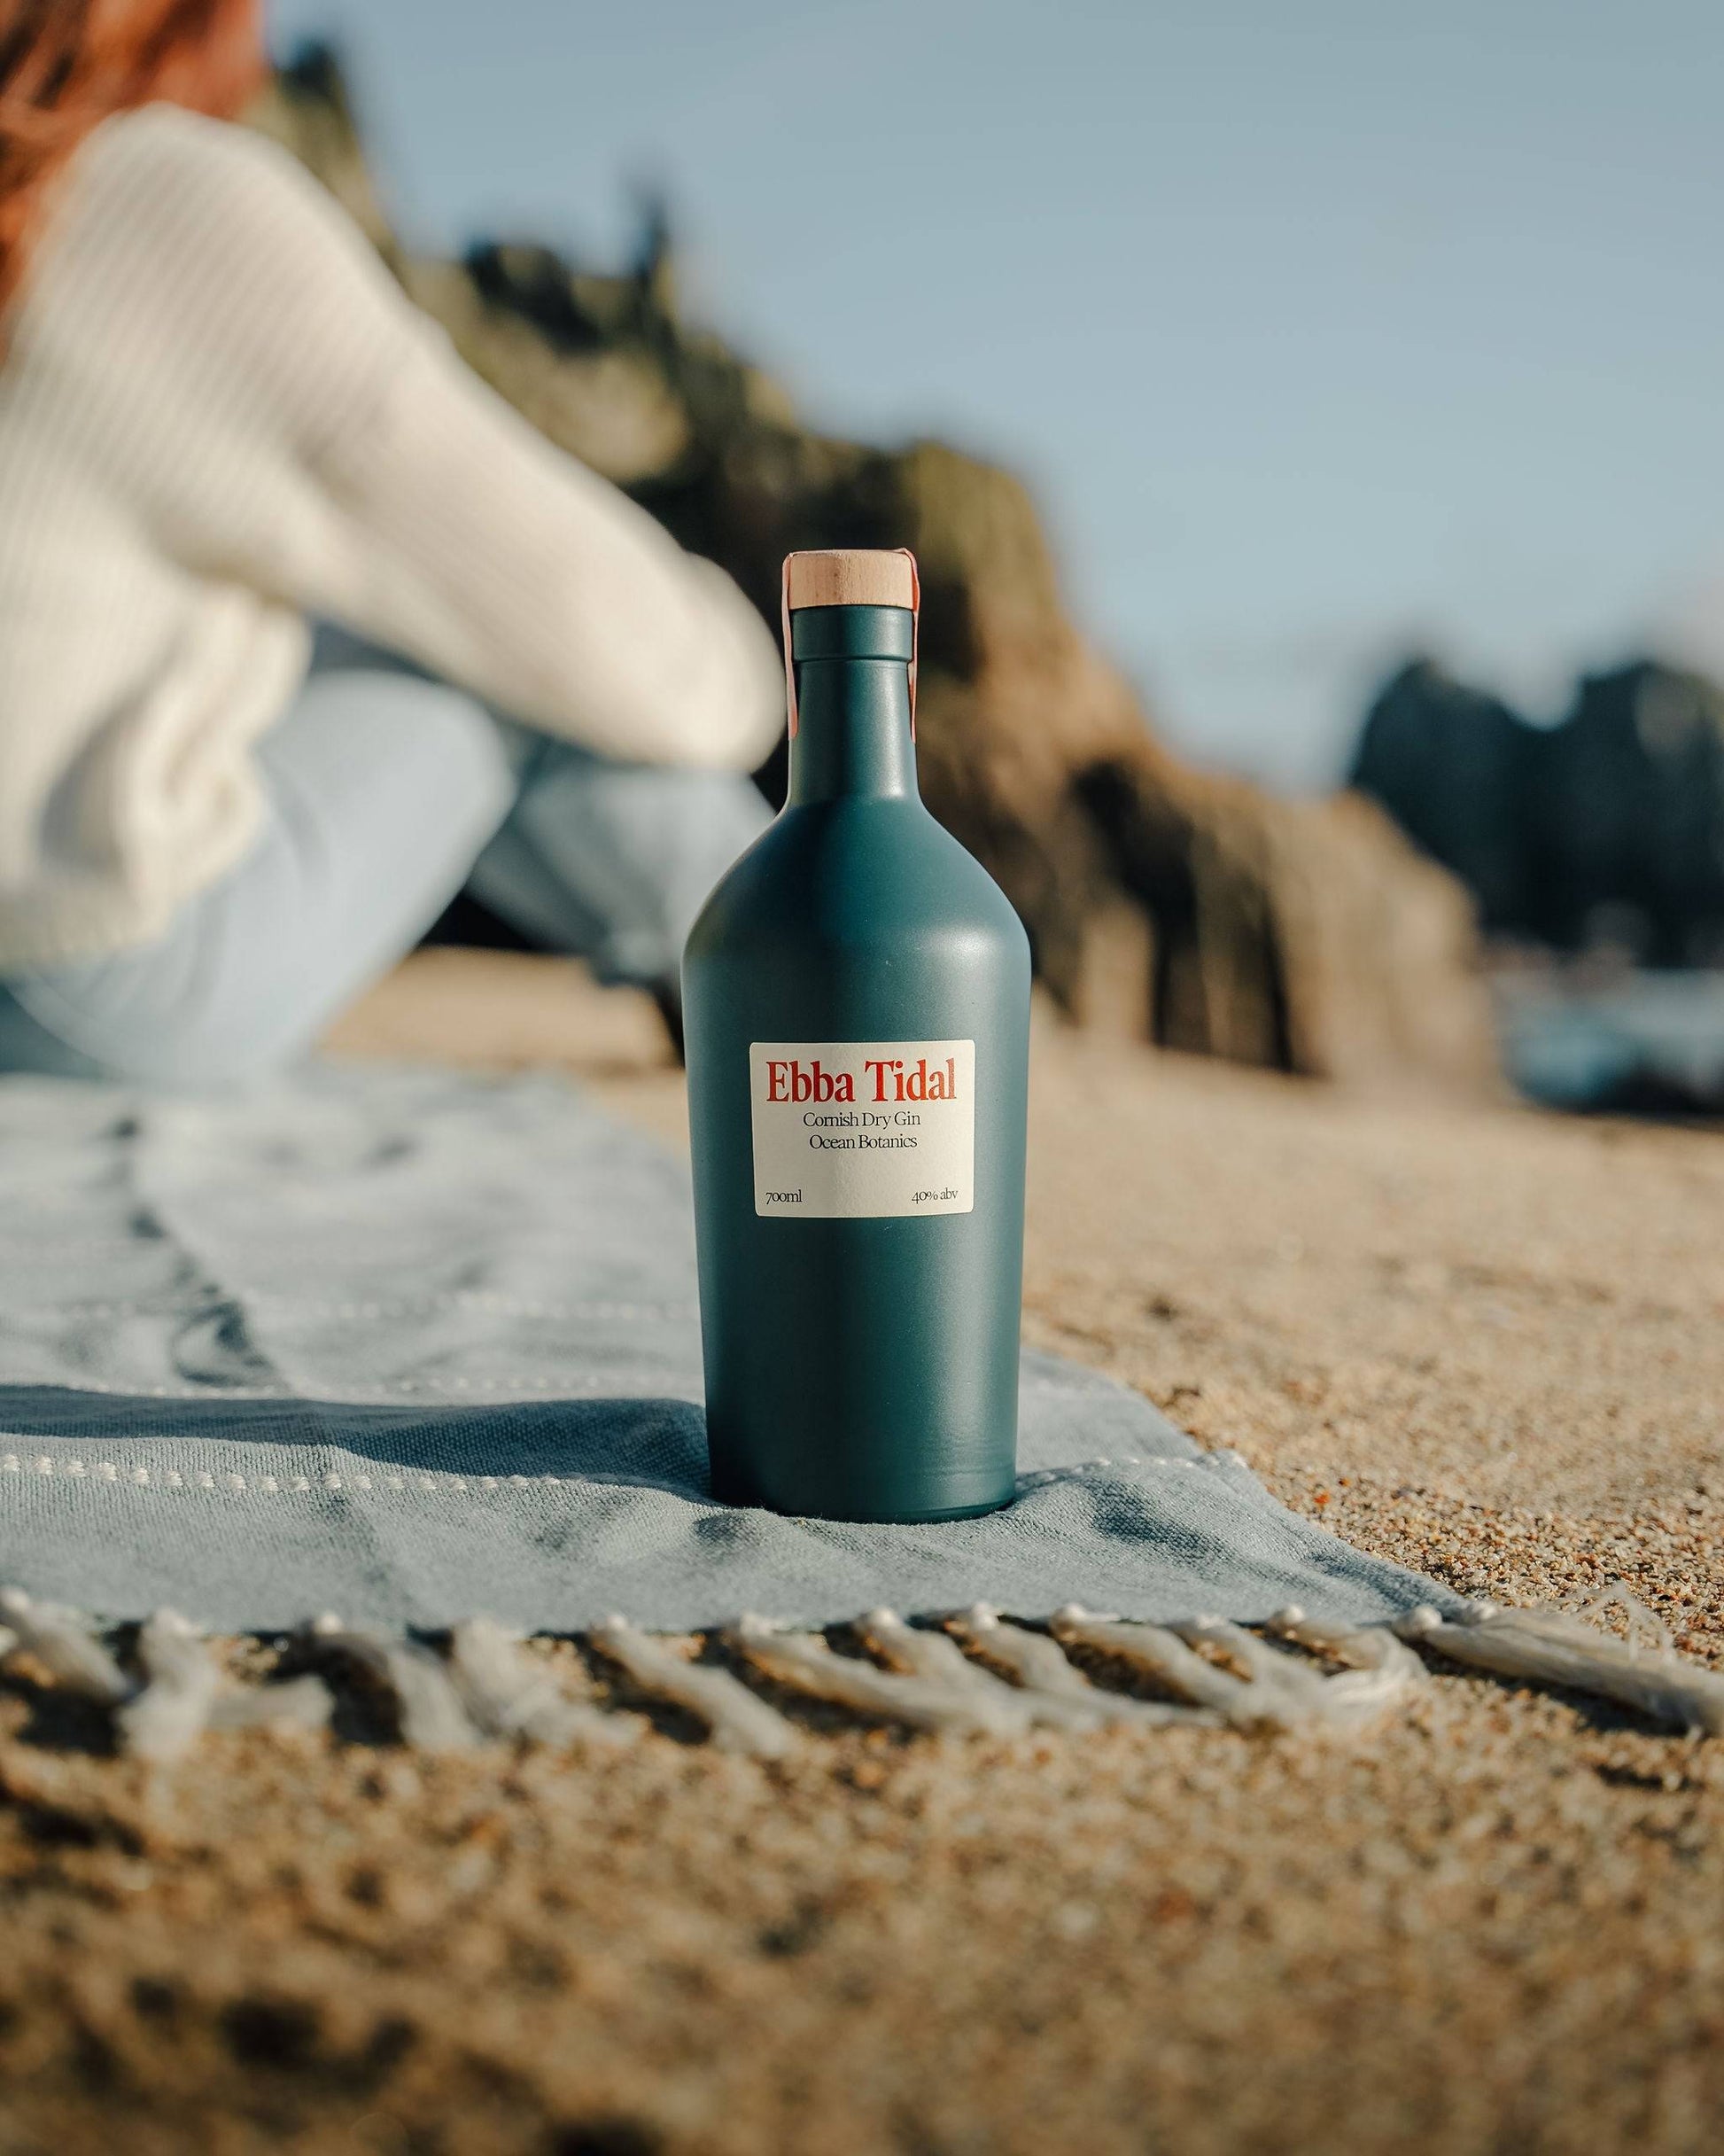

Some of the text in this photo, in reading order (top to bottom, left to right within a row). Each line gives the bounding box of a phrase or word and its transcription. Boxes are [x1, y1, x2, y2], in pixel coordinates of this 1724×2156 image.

[766, 1057, 958, 1102] Ebba Tidal
[803, 1110, 921, 1130] Cornish Dry Gin
[809, 1133, 918, 1149] Ocean Botanics
[765, 1189, 803, 1205] 700ml
[911, 1187, 959, 1204] 40% abv
